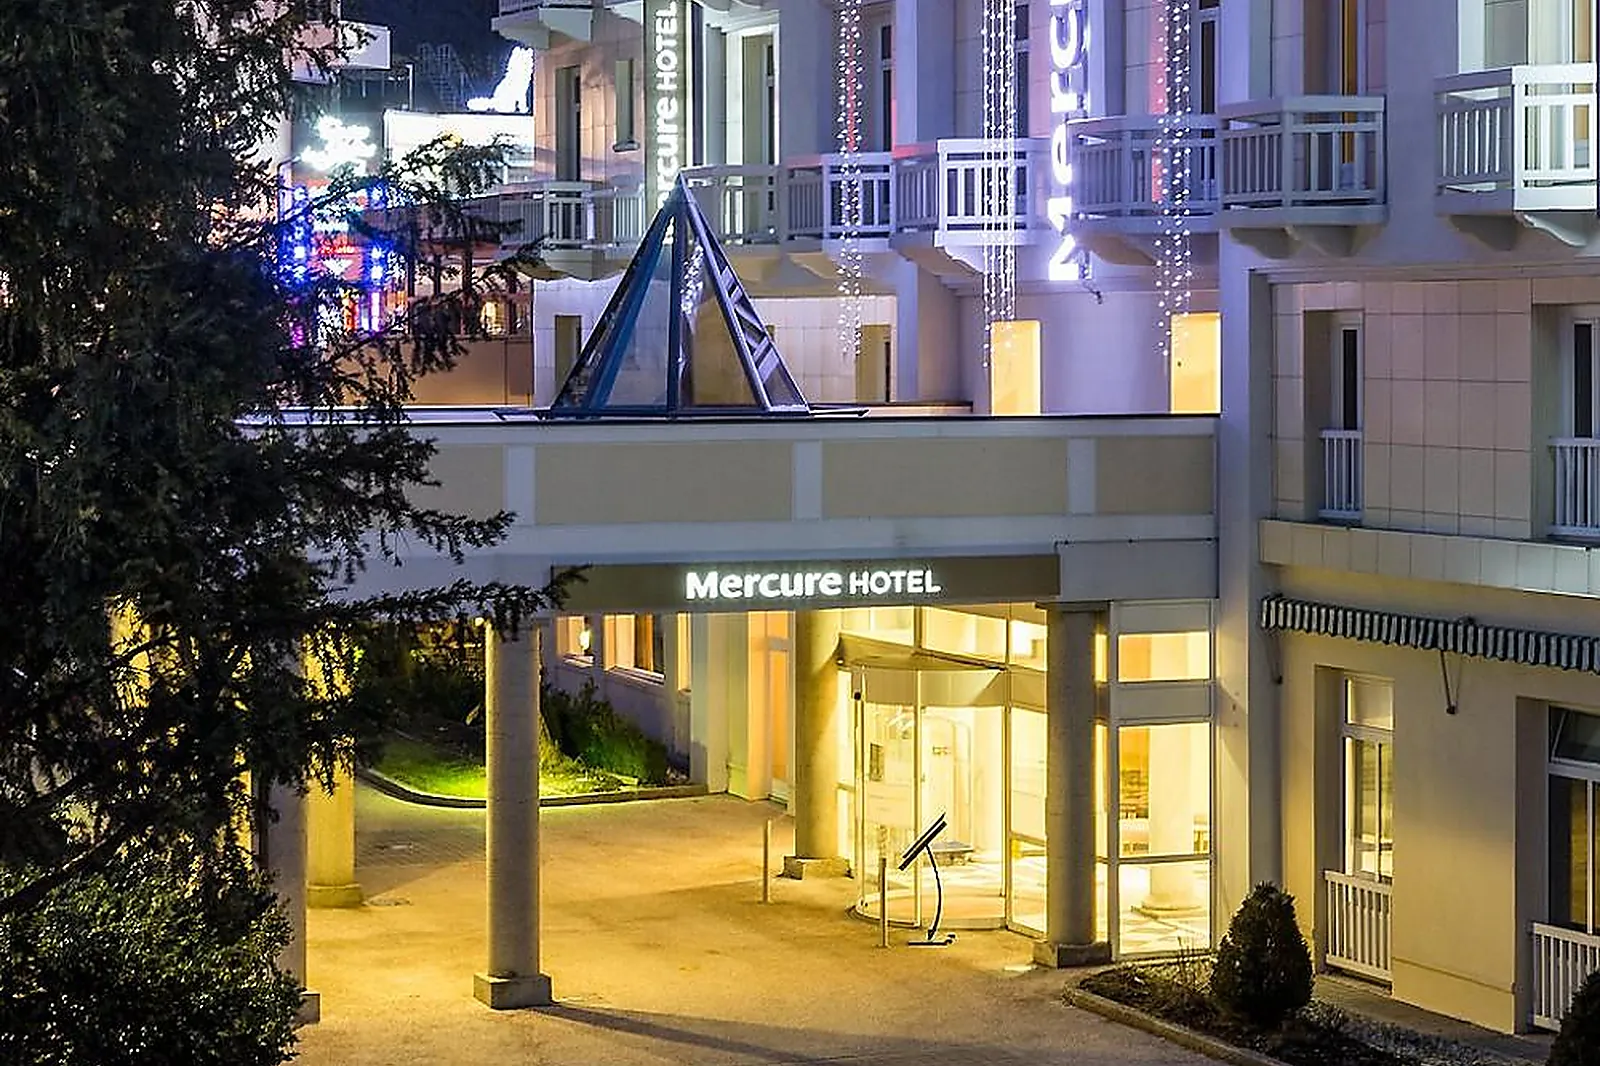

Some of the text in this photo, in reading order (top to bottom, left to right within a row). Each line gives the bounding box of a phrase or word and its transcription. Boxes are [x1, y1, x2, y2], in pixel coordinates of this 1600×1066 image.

[656, 1, 678, 90] HOTEL
[1049, 0, 1079, 280] Merc
[686, 569, 941, 599] Mercure HOTEL
